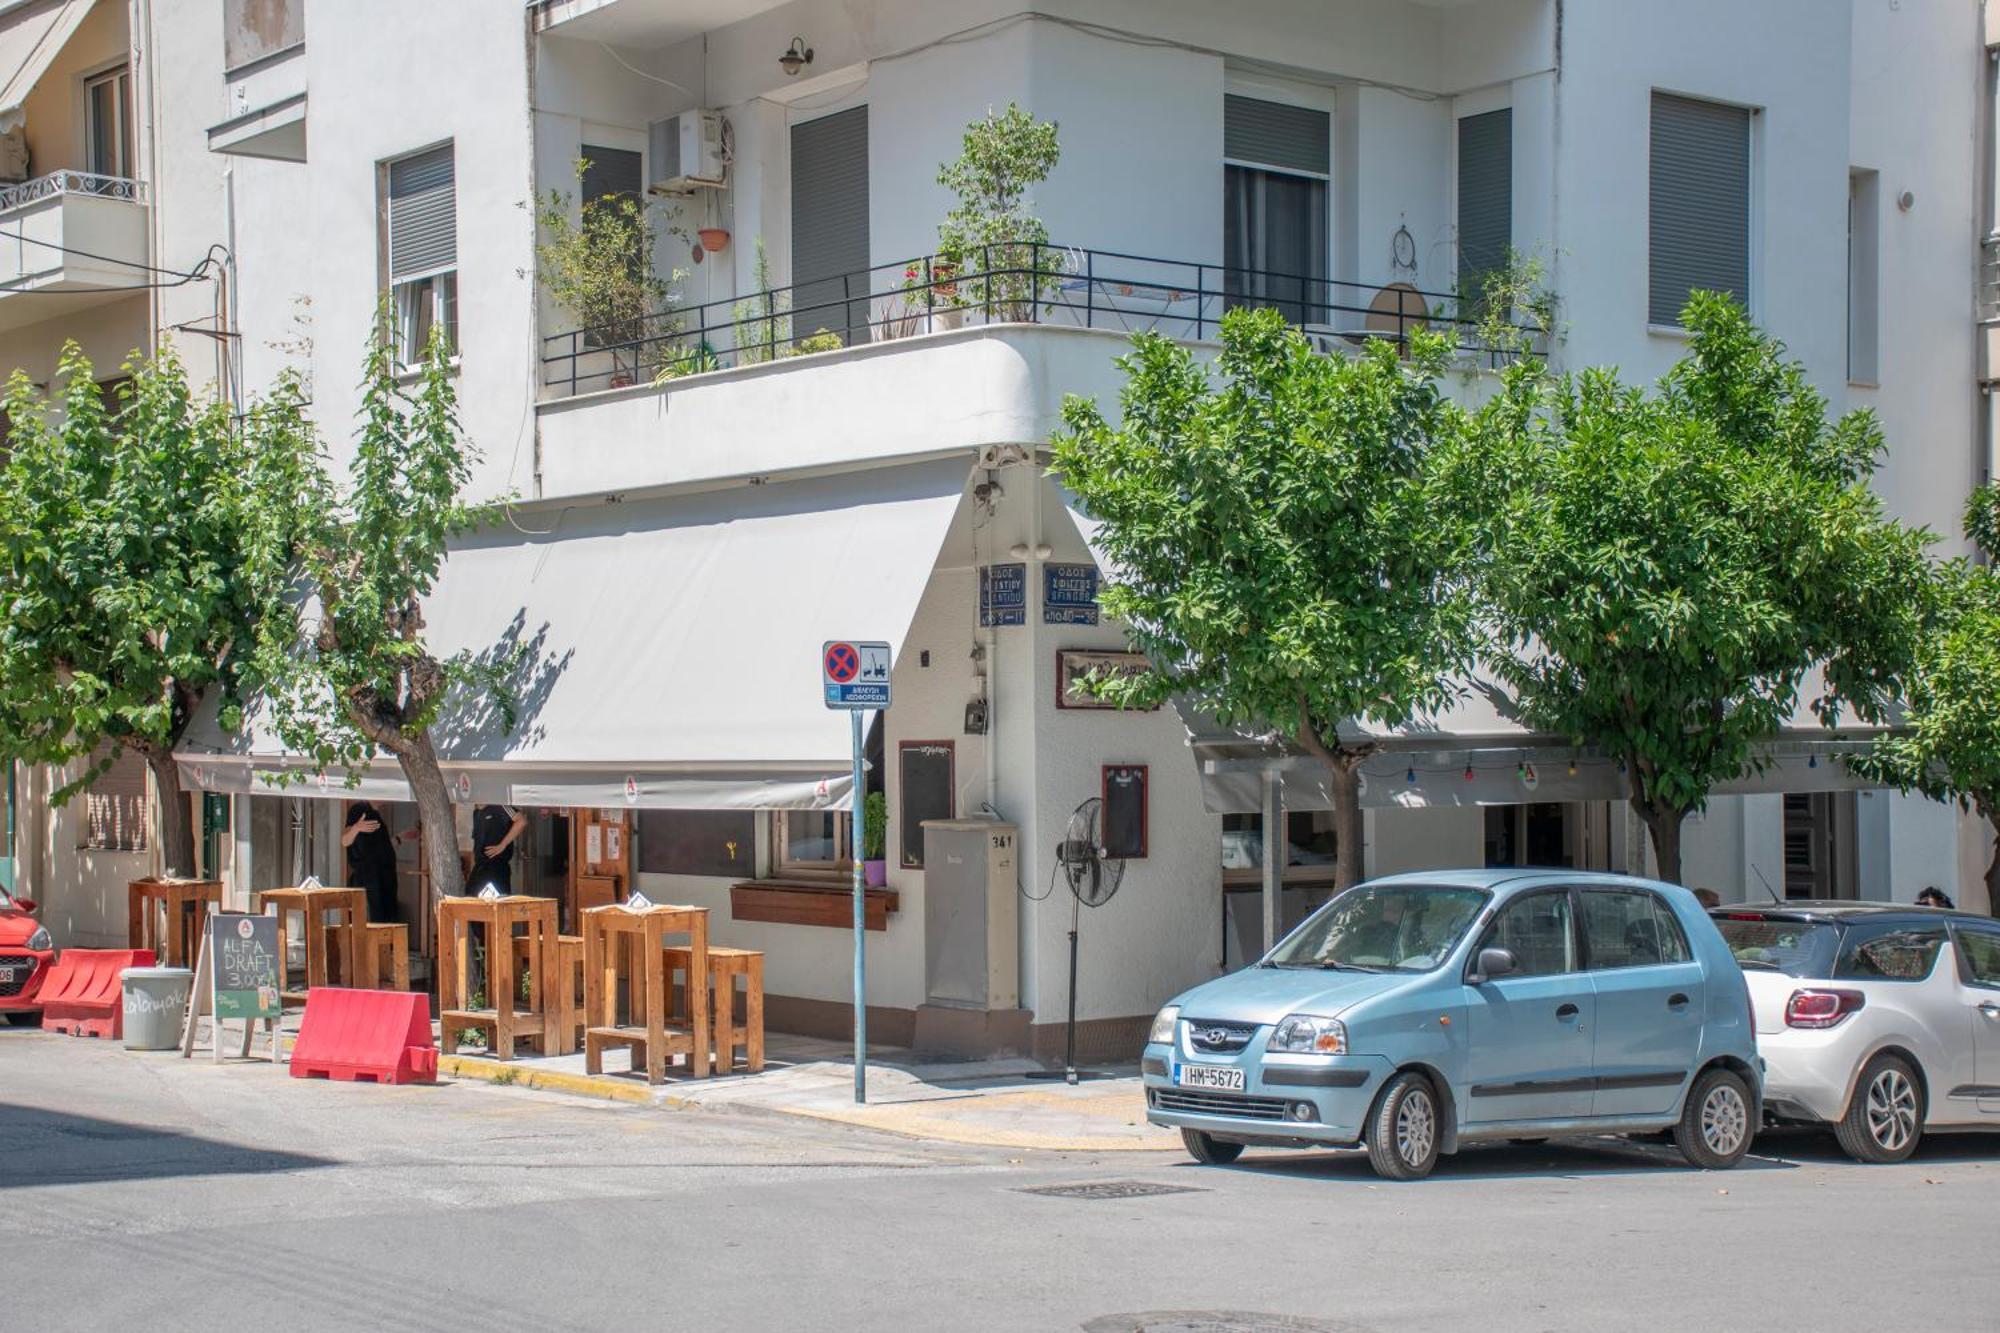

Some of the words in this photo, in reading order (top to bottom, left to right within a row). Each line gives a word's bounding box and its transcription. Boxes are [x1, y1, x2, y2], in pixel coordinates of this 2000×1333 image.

[1058, 567, 1086, 577] ΟΔΟΣ
[223, 938, 265, 954] ALFA
[224, 954, 274, 972] DRAFT
